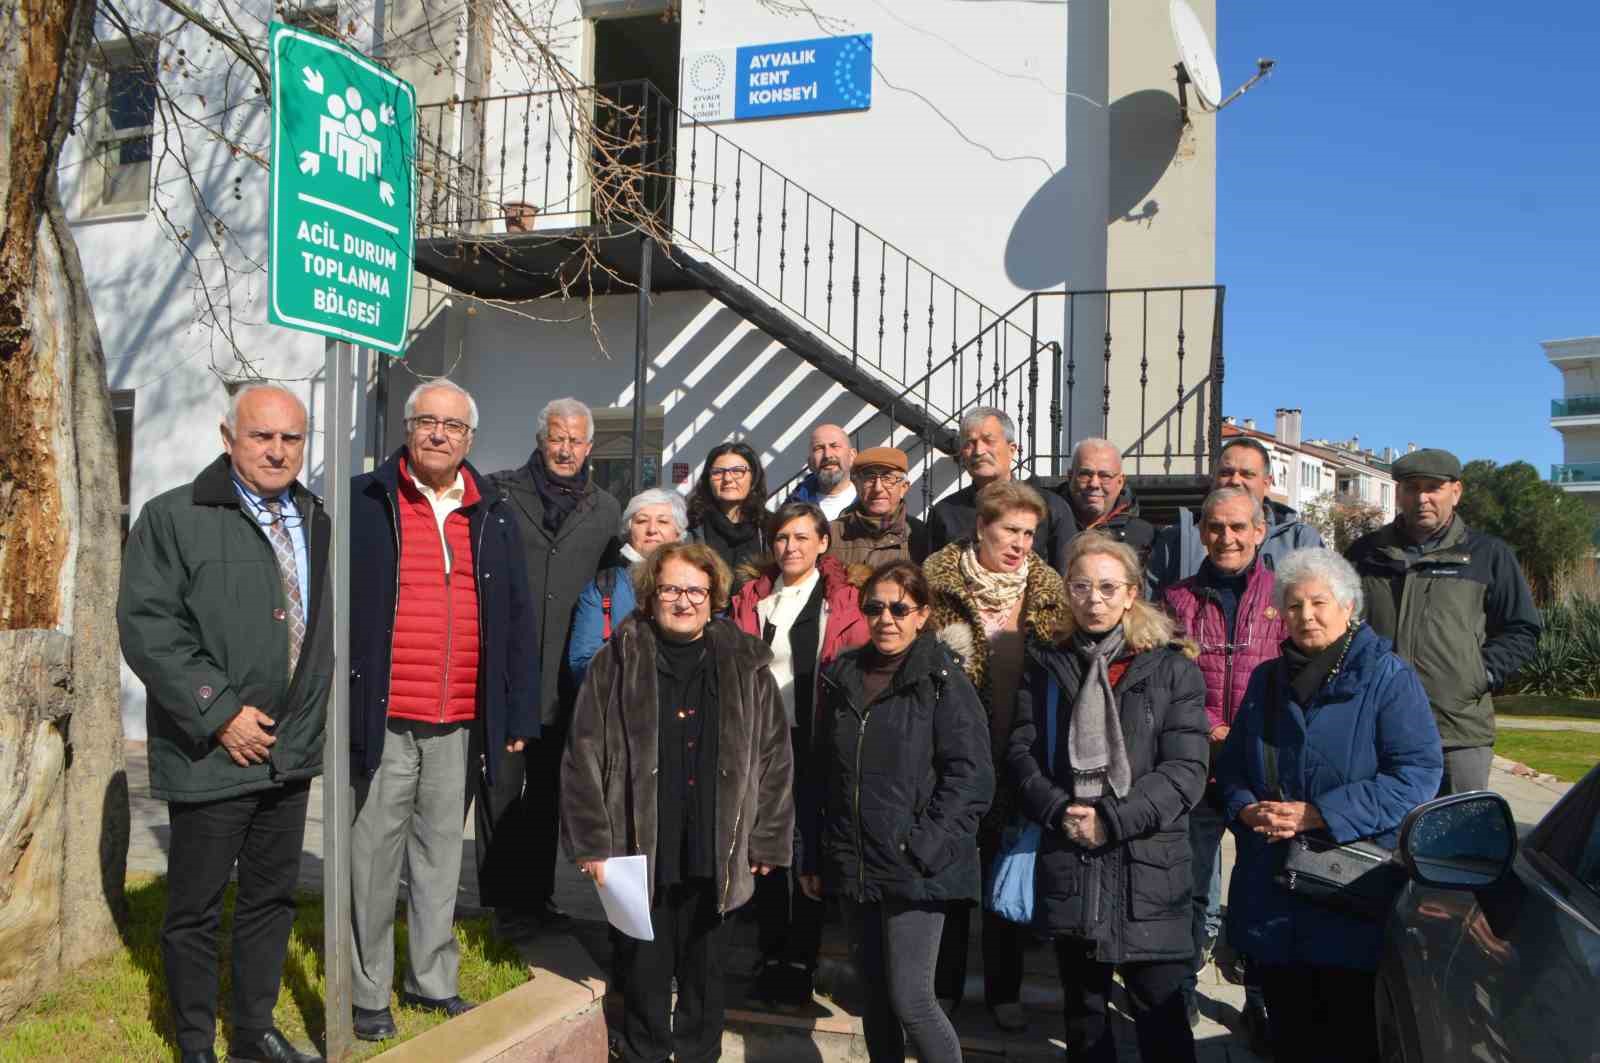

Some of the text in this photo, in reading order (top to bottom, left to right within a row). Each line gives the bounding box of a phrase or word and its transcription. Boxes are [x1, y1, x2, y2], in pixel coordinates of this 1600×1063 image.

[749, 49, 816, 70] AYVALIK
[749, 70, 790, 87] KENT
[749, 81, 817, 105] KONSEYİ
[296, 219, 397, 271] ACİL DURUM
[301, 251, 391, 298] TOPLANMA
[313, 287, 382, 328] BÖLGESİ
